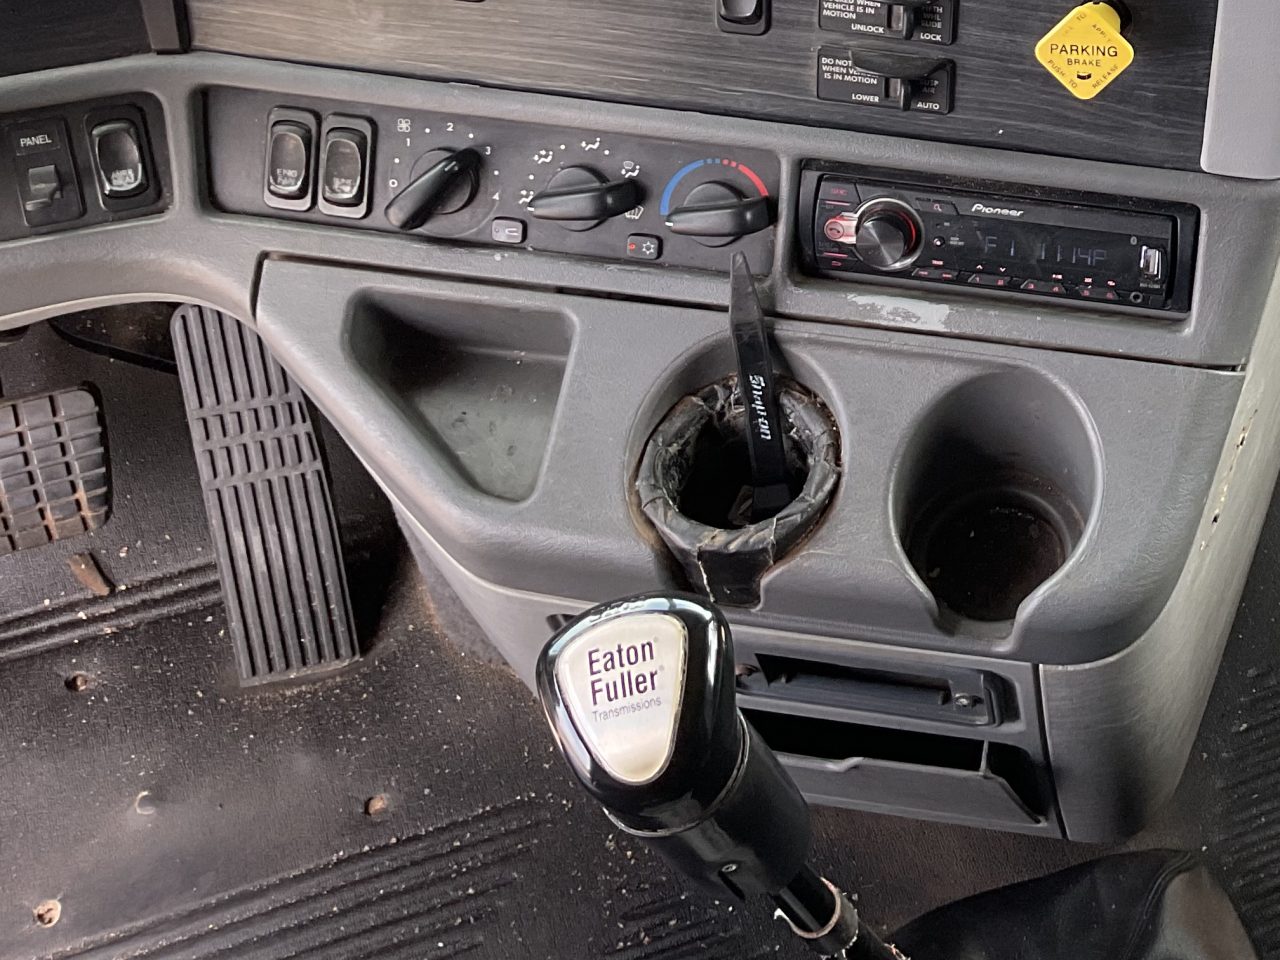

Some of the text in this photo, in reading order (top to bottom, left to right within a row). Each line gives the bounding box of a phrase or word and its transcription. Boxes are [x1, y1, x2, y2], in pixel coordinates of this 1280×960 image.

[823, 2, 855, 13] VEHICLE
[865, 7, 875, 15] IN
[856, 0, 881, 8] WHEN
[822, 10, 856, 20] MOTION
[851, 23, 885, 34] UNLOCK
[920, 32, 942, 42] LOCK
[1049, 43, 1118, 57] PARKING
[821, 57, 852, 67] DO NOT
[1067, 58, 1101, 67] BRAKE
[821, 65, 847, 74] WHEN
[1047, 59, 1119, 89] PUSH TO RELEASE
[824, 72, 832, 80] IS
[833, 73, 843, 81] IN
[844, 74, 878, 85] MOTION
[851, 93, 880, 103] LOWER
[916, 101, 940, 110] AUTO
[446, 122, 454, 132] 2
[19, 134, 52, 147] PANEL
[406, 137, 411, 147] 1
[485, 146, 492, 155] 3
[492, 191, 500, 201] 4
[971, 203, 1024, 217] Pioneer
[592, 697, 662, 723] Transmissions
